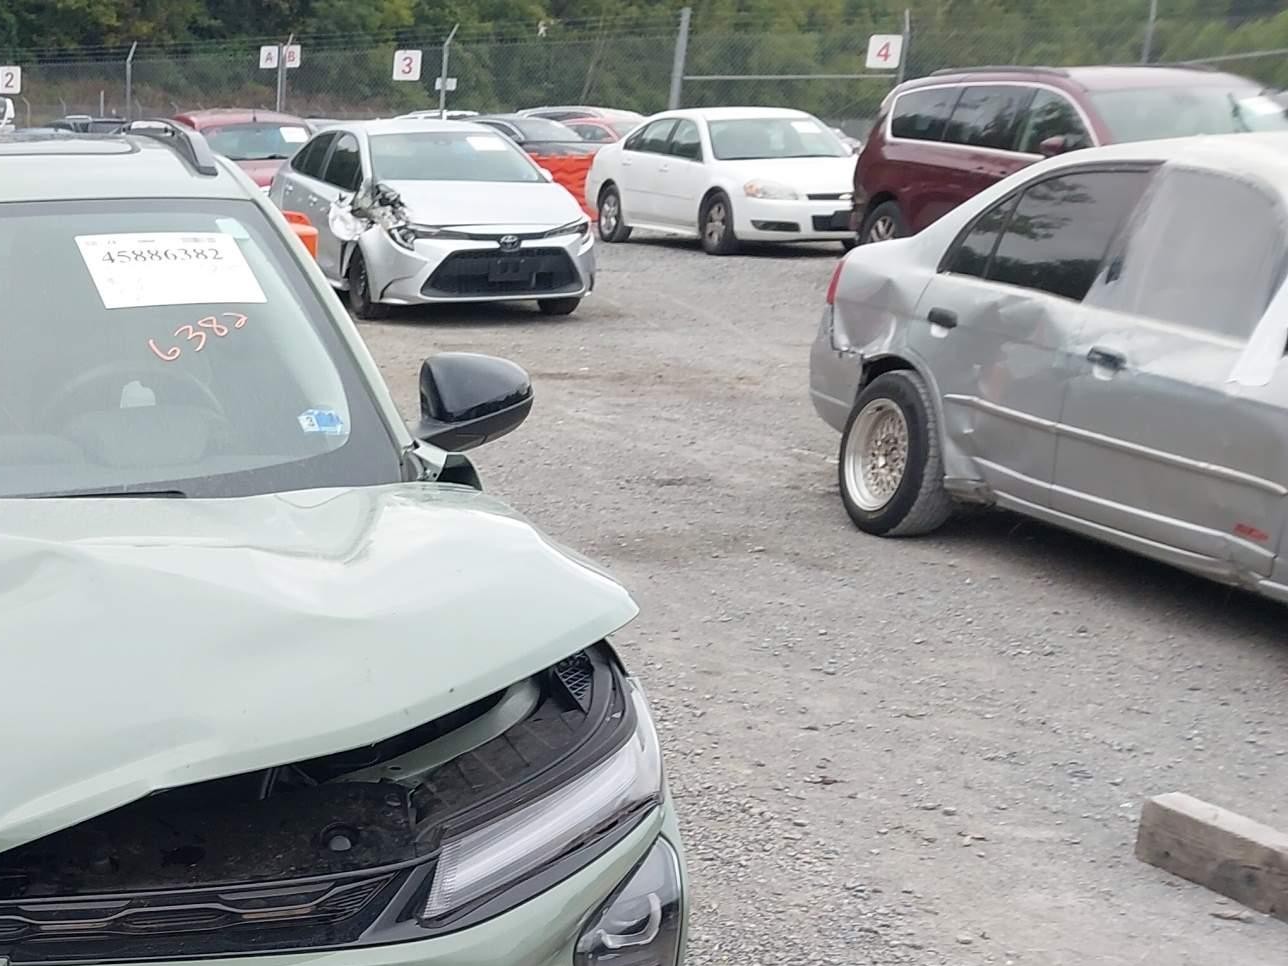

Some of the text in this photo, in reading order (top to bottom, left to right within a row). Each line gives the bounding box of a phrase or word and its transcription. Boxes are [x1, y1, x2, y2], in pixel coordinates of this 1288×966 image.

[264, 51, 273, 63] A
[287, 50, 297, 63] B
[876, 41, 892, 62] 4
[401, 56, 413, 74] 3
[4, 71, 14, 88] 2
[102, 247, 224, 264] 45886382
[148, 311, 248, 361] 6382
